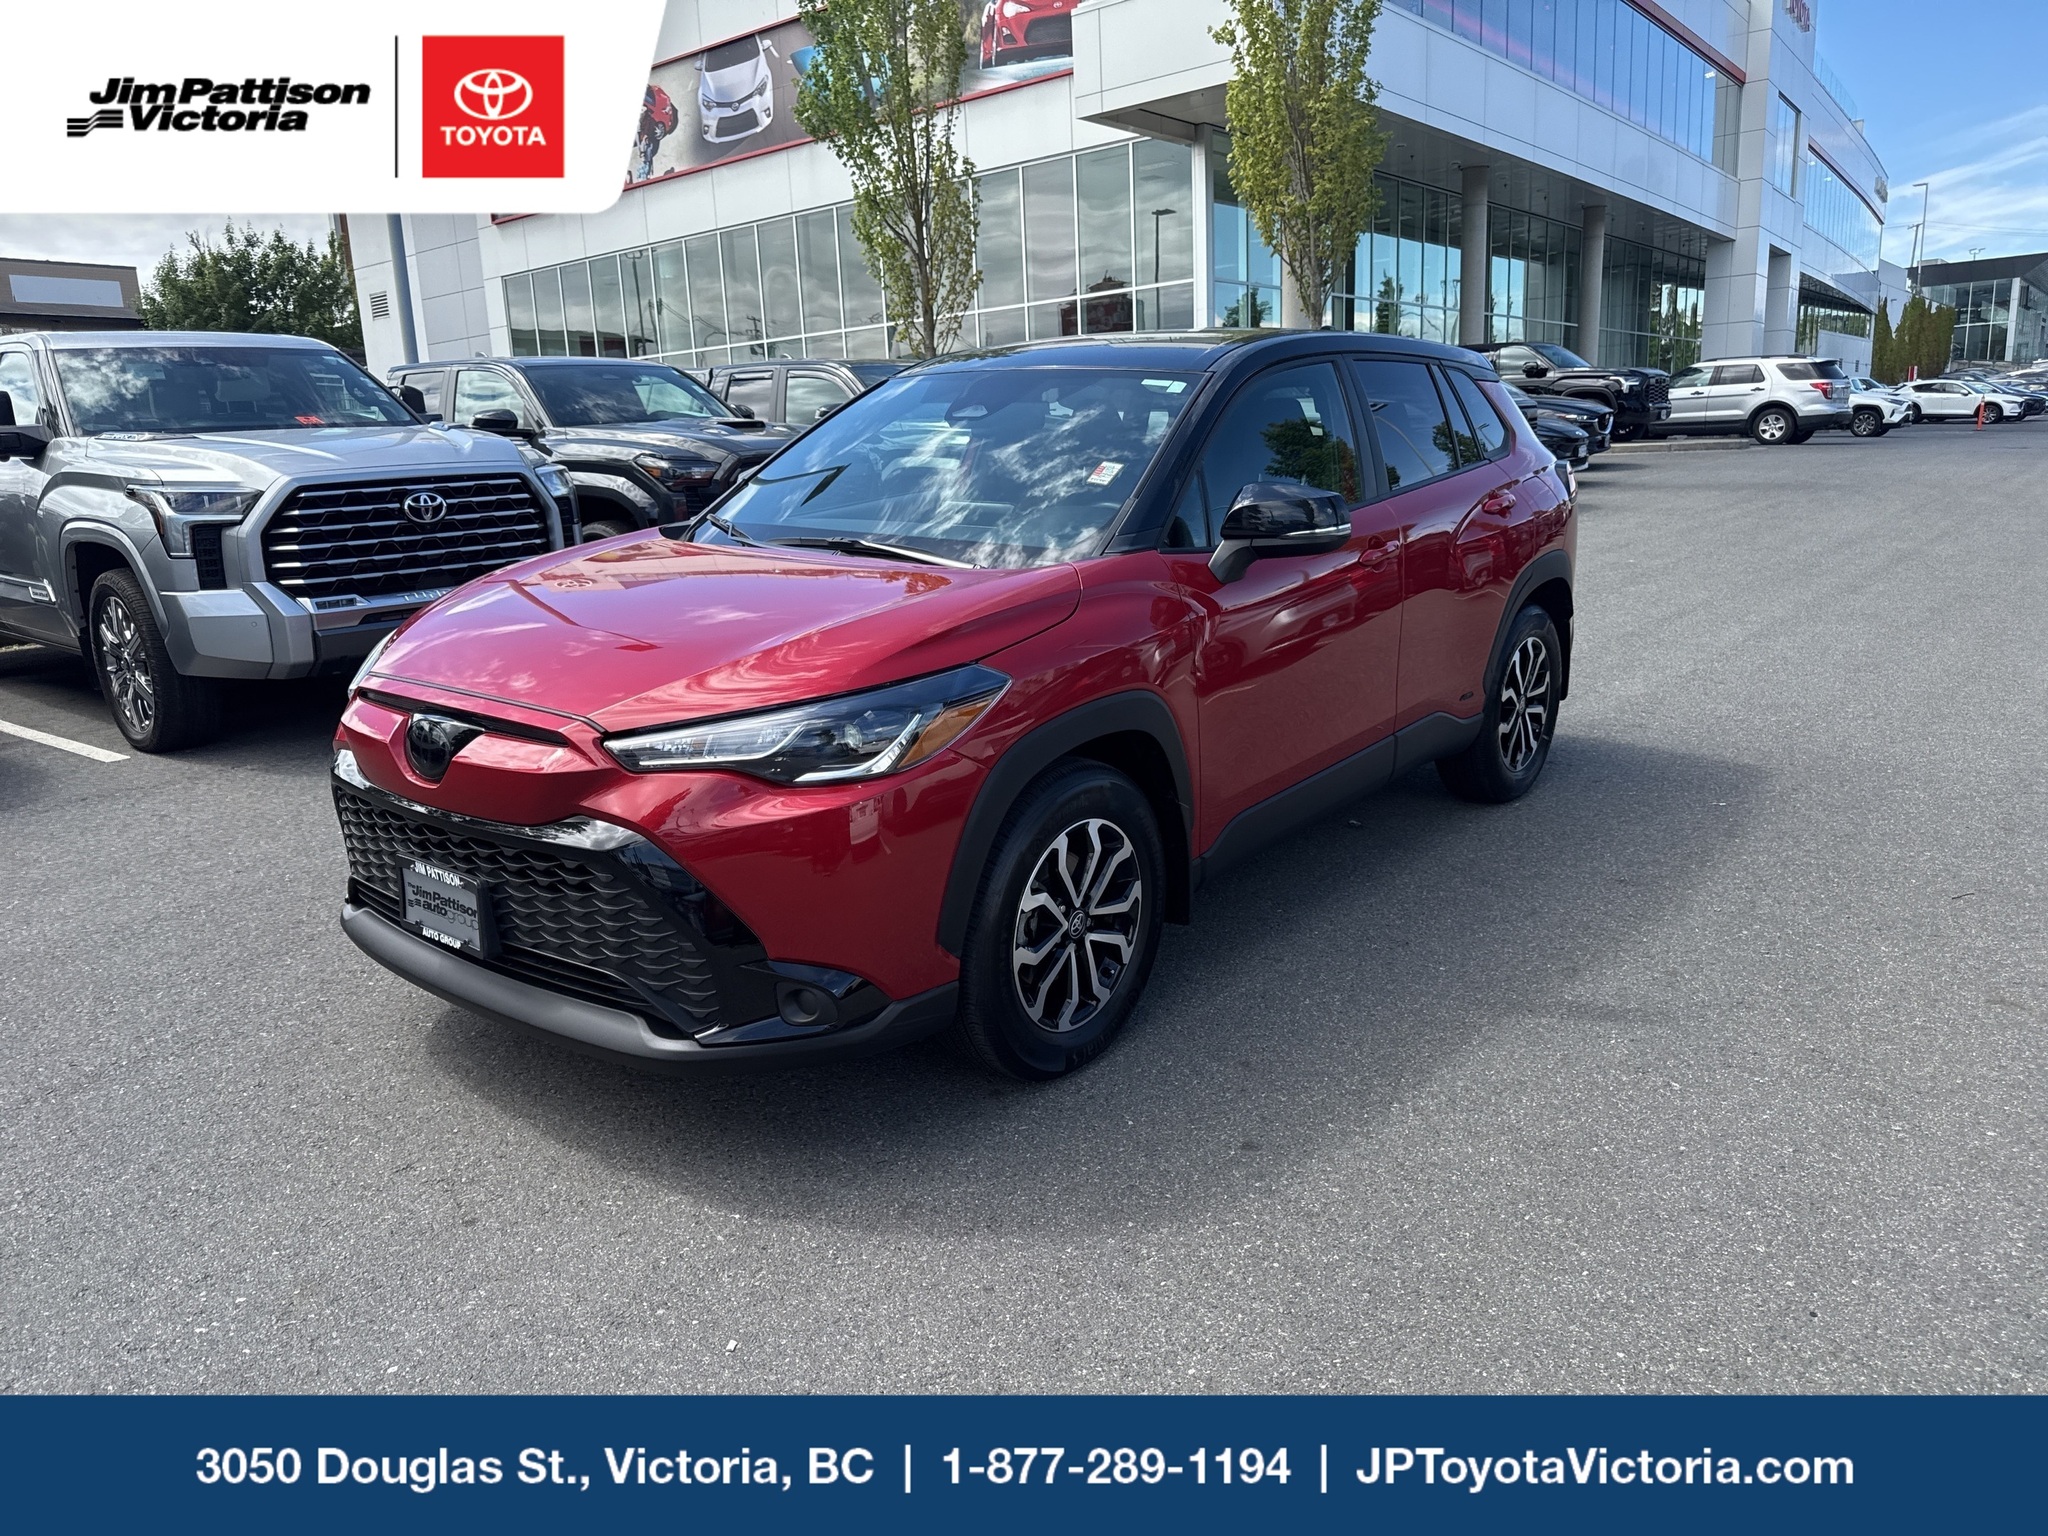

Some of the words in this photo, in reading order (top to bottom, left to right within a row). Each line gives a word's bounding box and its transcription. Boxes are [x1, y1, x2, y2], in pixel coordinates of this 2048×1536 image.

[414, 860, 427, 876] JIM
[426, 865, 461, 887] PATTISON
[422, 926, 439, 941] AUTO
[439, 933, 462, 949] GROUP
